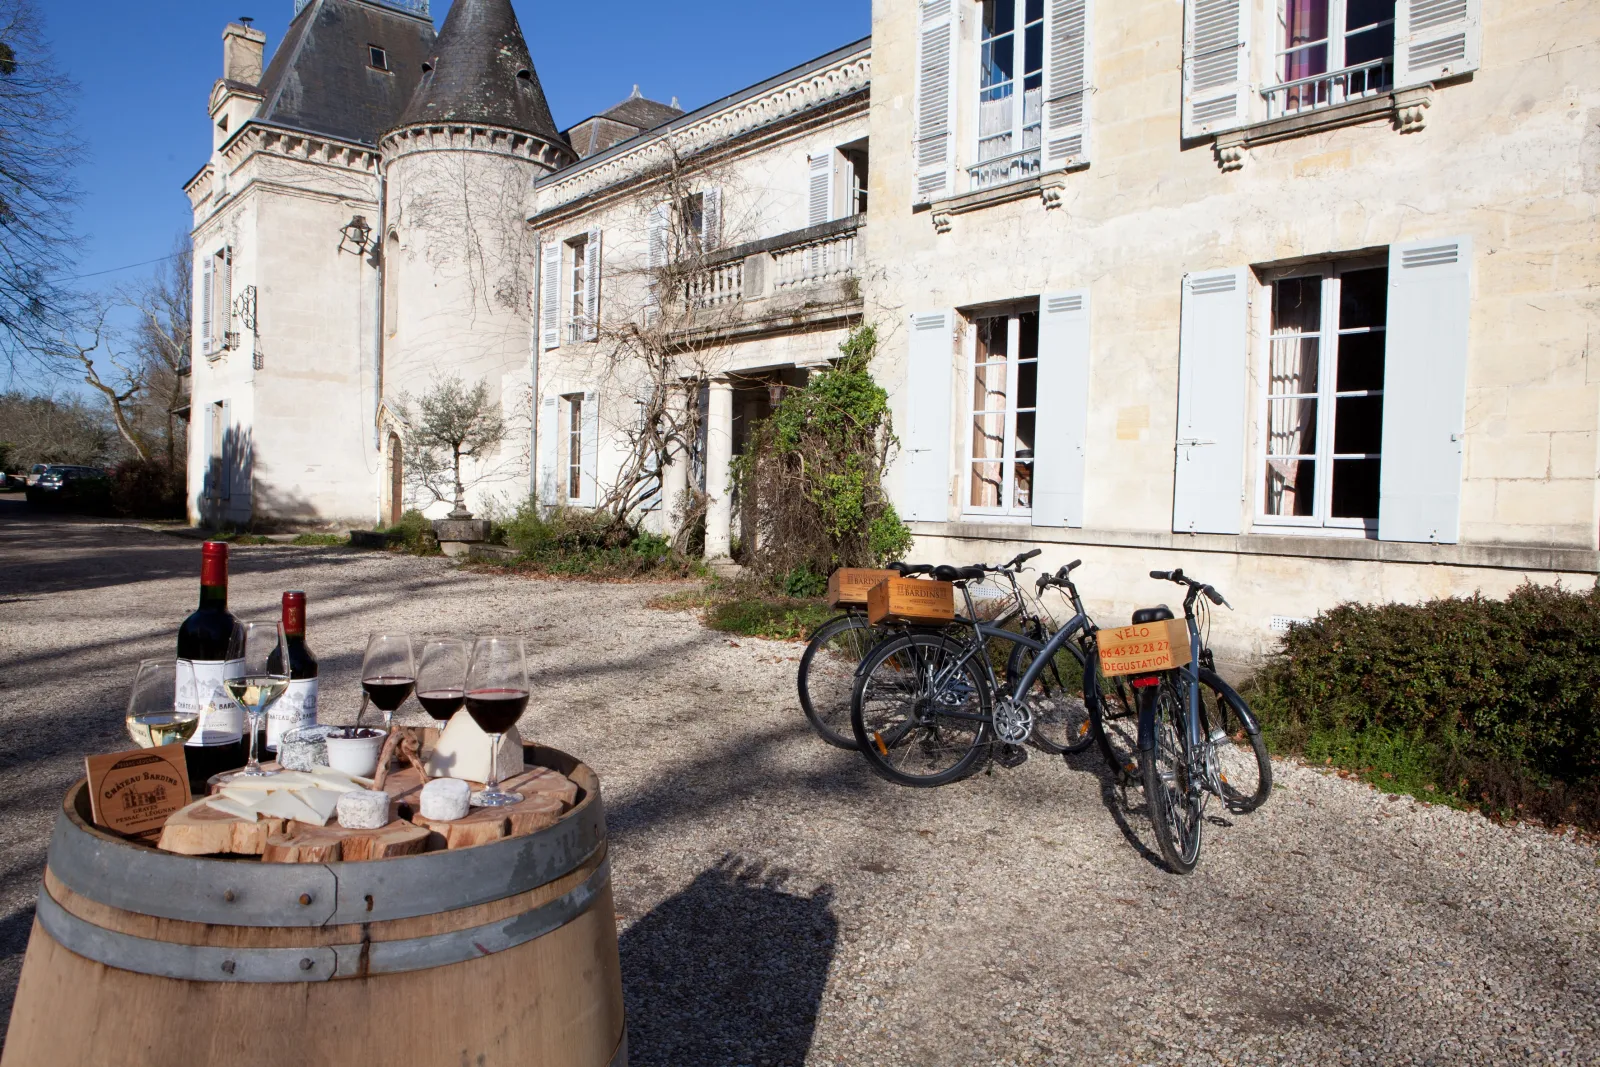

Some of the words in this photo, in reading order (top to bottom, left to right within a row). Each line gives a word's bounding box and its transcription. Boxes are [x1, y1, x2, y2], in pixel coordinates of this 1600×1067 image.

[905, 588, 940, 598] BARDINS
[1115, 627, 1150, 640] VELO
[1100, 648, 1112, 658] 06
[1115, 647, 1126, 656] 45
[1128, 645, 1140, 655] 22
[1143, 643, 1155, 653] 28
[1157, 641, 1169, 651] 27
[1103, 653, 1170, 671] DEGUSTATION
[104, 775, 141, 799] CHÂTEAU
[142, 771, 178, 786] BARDINS
[132, 805, 158, 814] GRAVES
